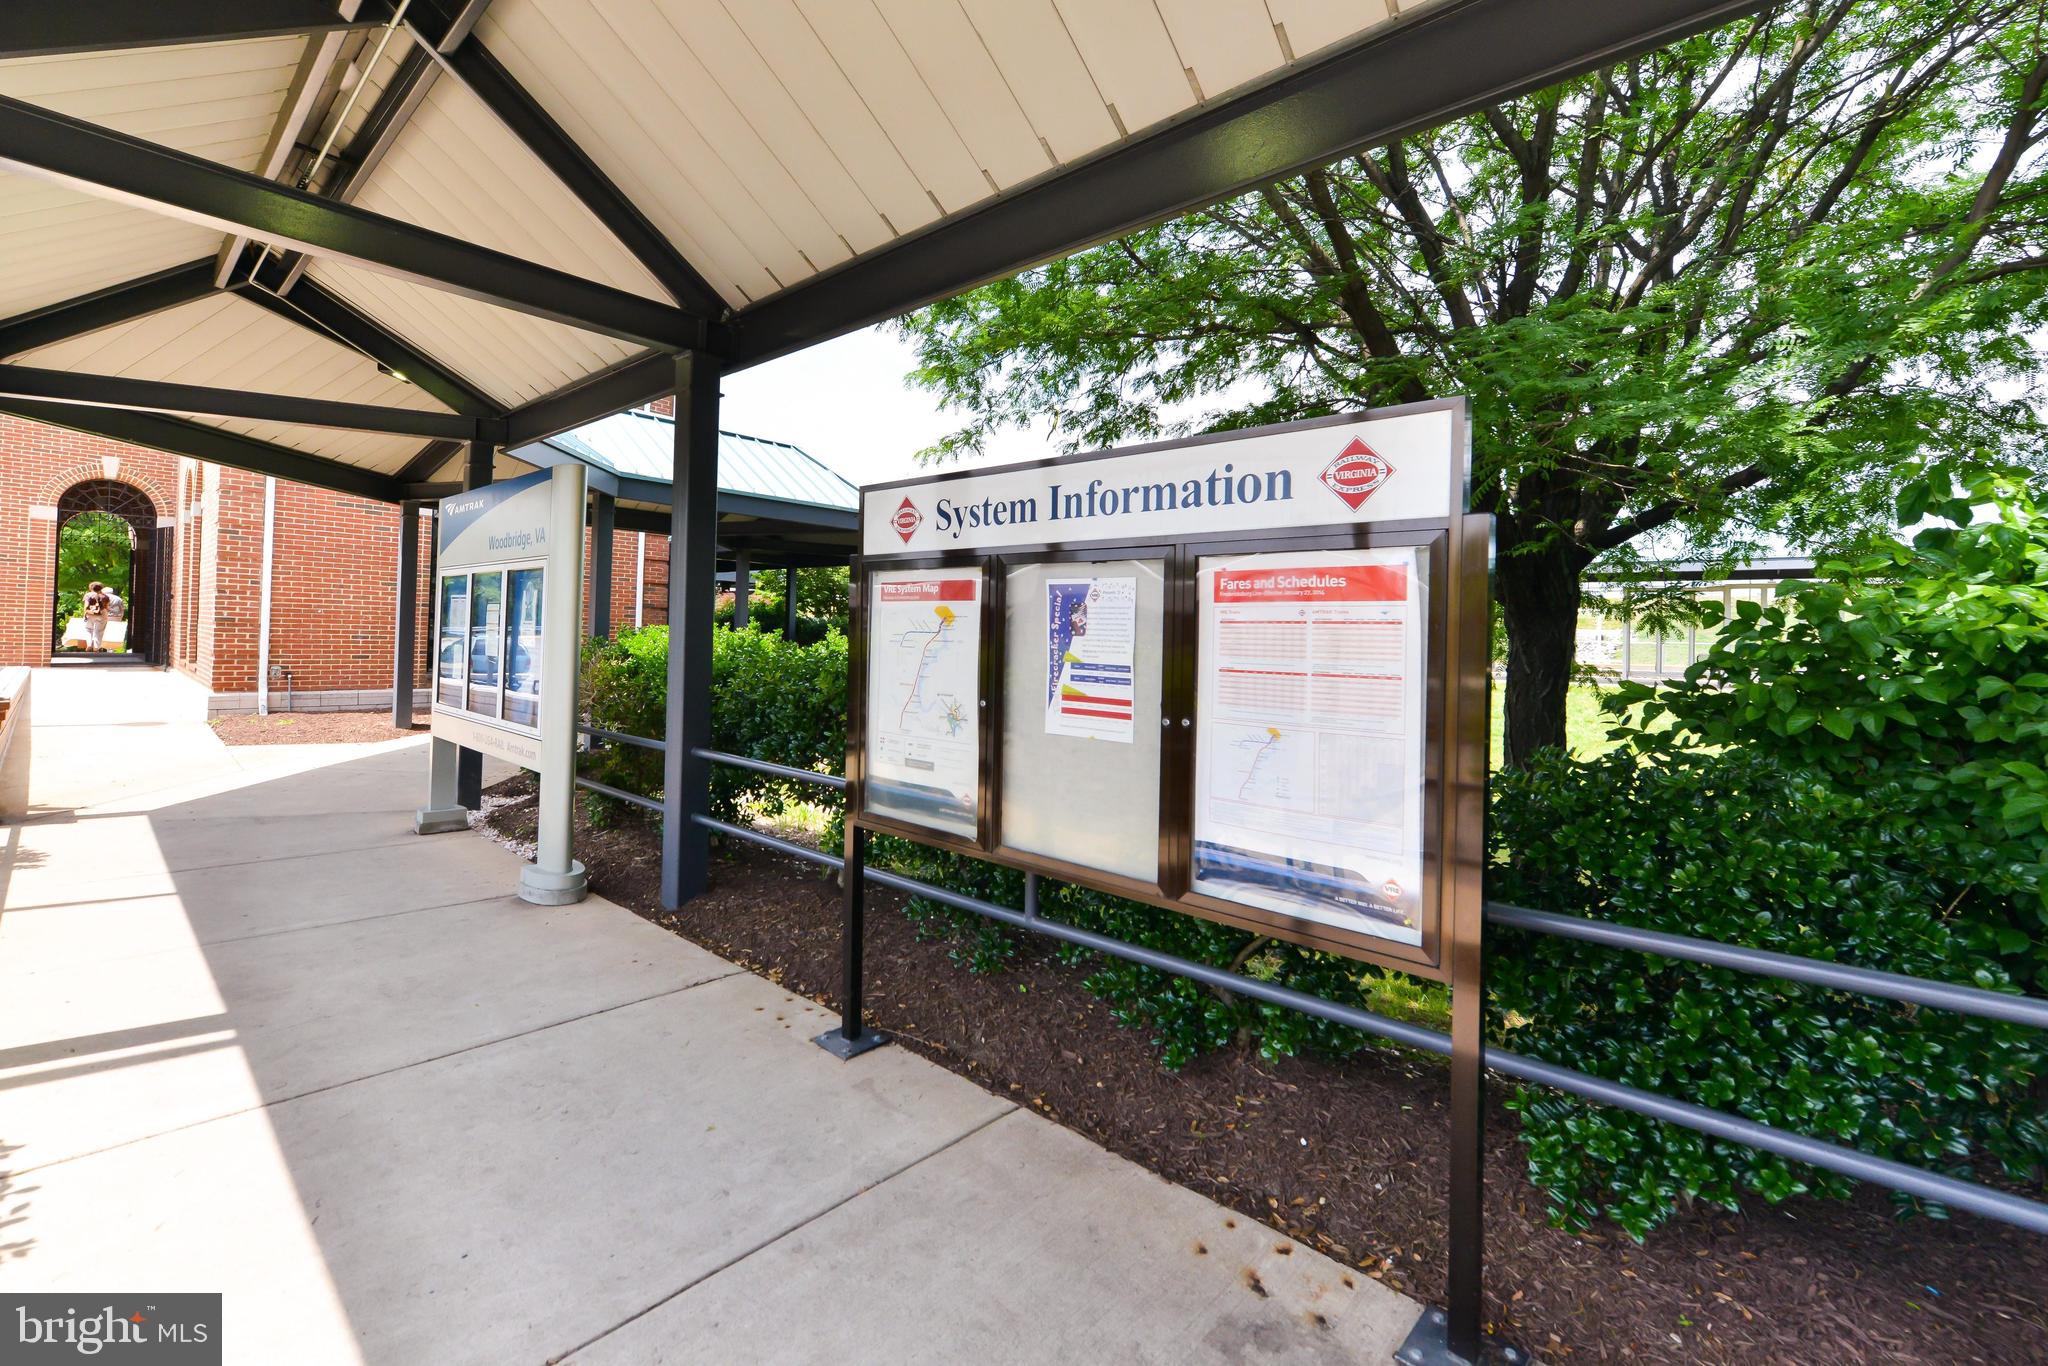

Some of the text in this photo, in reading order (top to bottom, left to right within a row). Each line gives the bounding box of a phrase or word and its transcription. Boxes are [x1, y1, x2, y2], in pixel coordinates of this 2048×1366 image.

[1334, 455, 1380, 468] RAILWAY
[1335, 468, 1377, 480] VIRGINIA
[1332, 479, 1379, 492] EXPRESS
[454, 499, 484, 514] AMTRAK
[935, 463, 1295, 540] System Information
[488, 527, 546, 551] Woodbridge, VA
[897, 584, 921, 595] System
[922, 583, 939, 594] Map
[1220, 574, 1347, 590] Fares and Schedules
[1051, 590, 1064, 630] Special
[1384, 885, 1400, 894] VRE
